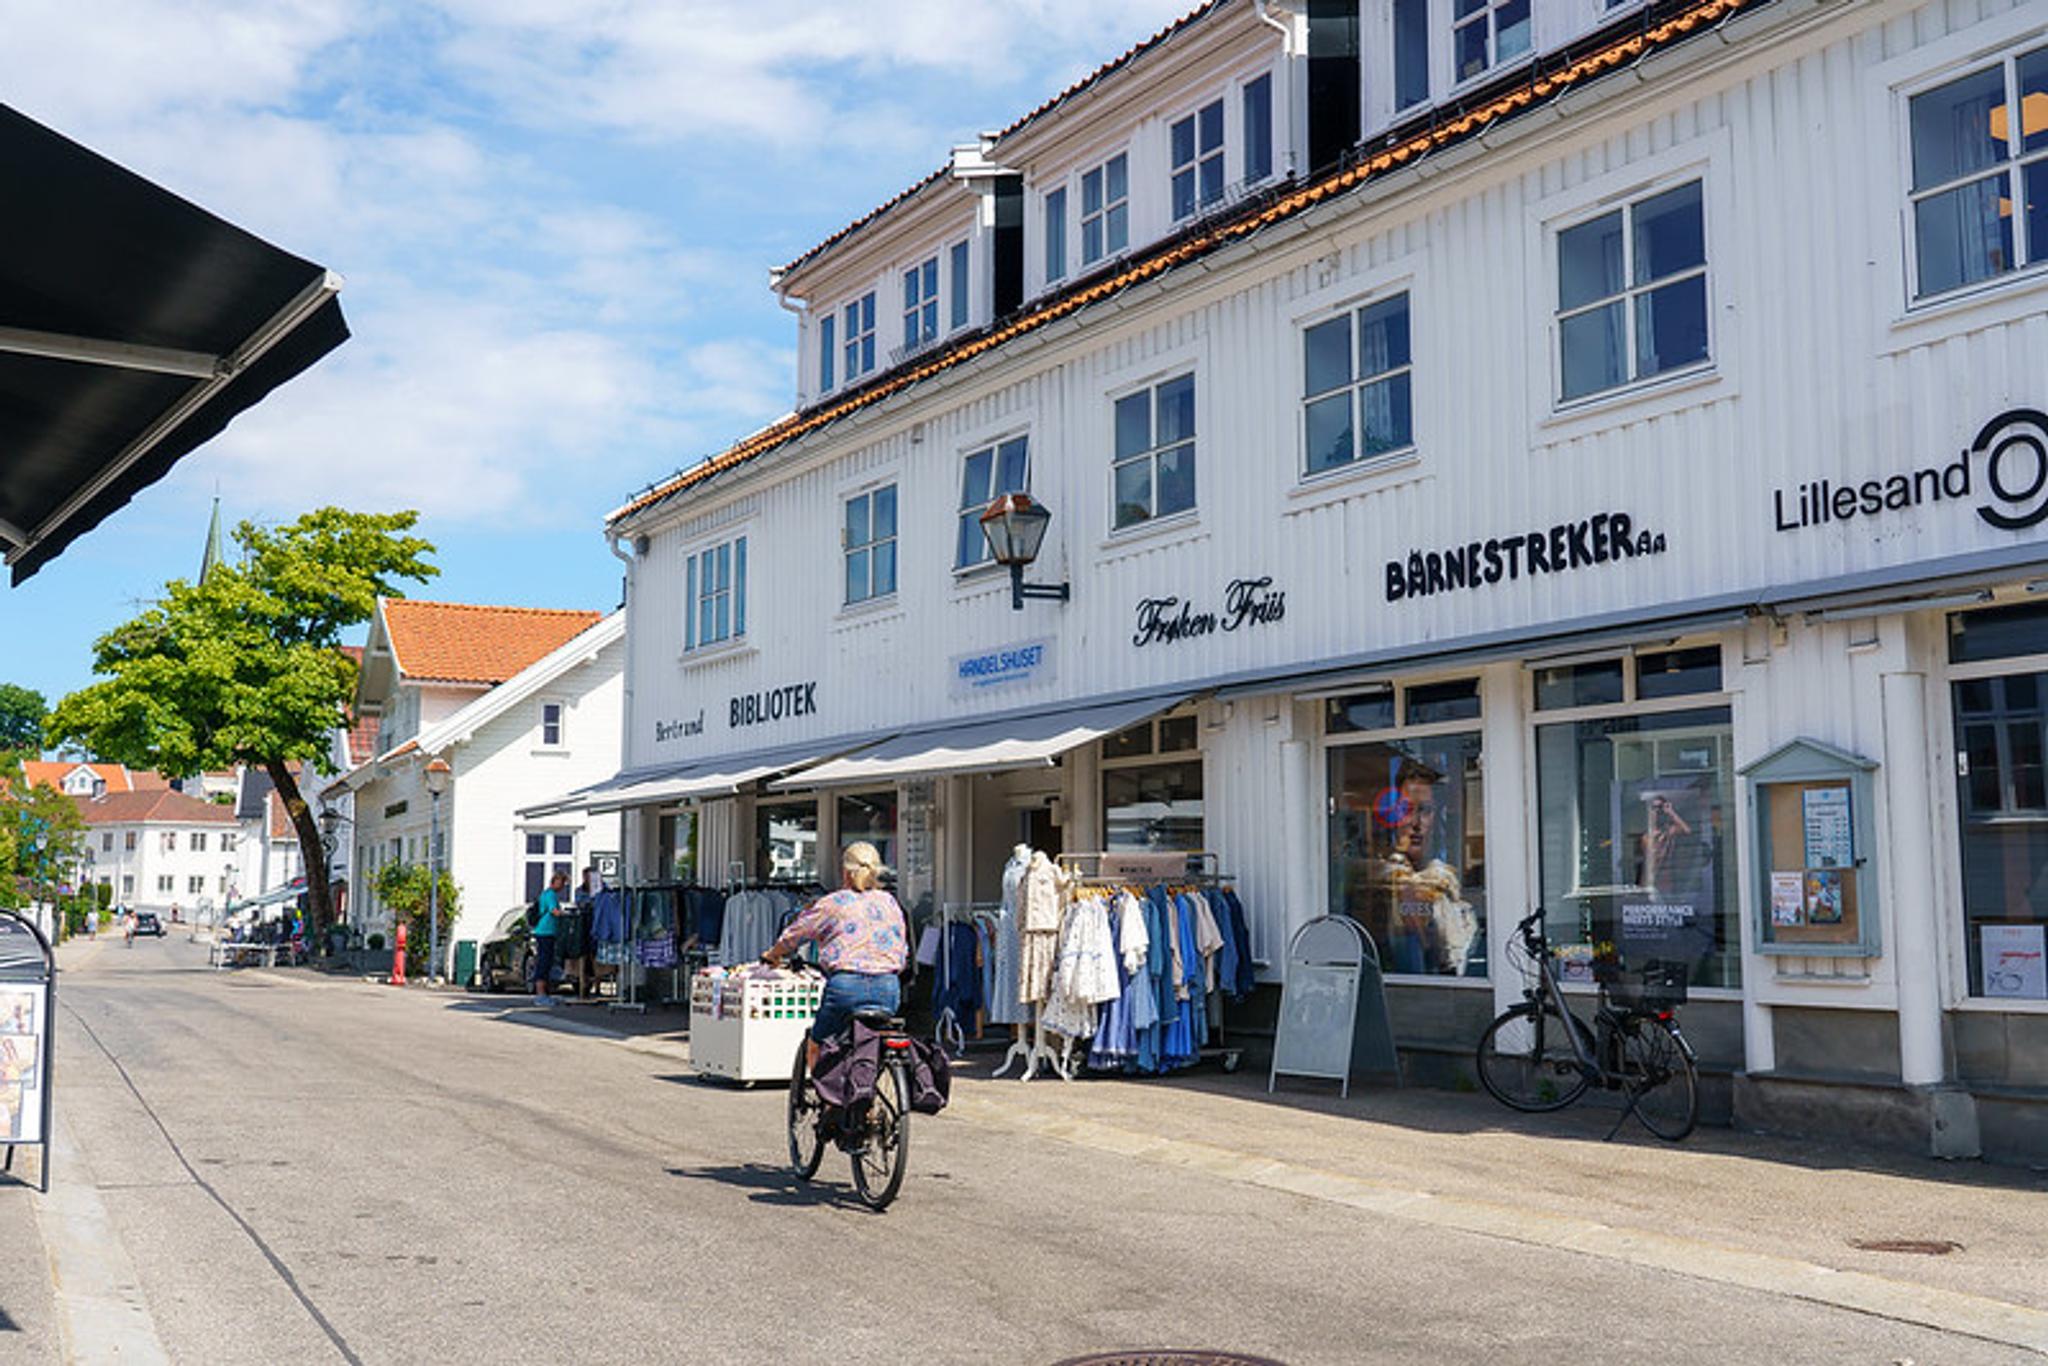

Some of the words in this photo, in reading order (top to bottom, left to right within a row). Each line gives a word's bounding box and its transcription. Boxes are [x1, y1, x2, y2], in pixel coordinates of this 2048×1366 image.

[1774, 448, 1971, 532] Lillesand
[1133, 597, 1217, 647] Frøken
[1221, 576, 1286, 631] Friis
[959, 645, 1043, 677] HANDELSHUSET
[730, 681, 817, 729] BIBLIOTEK
